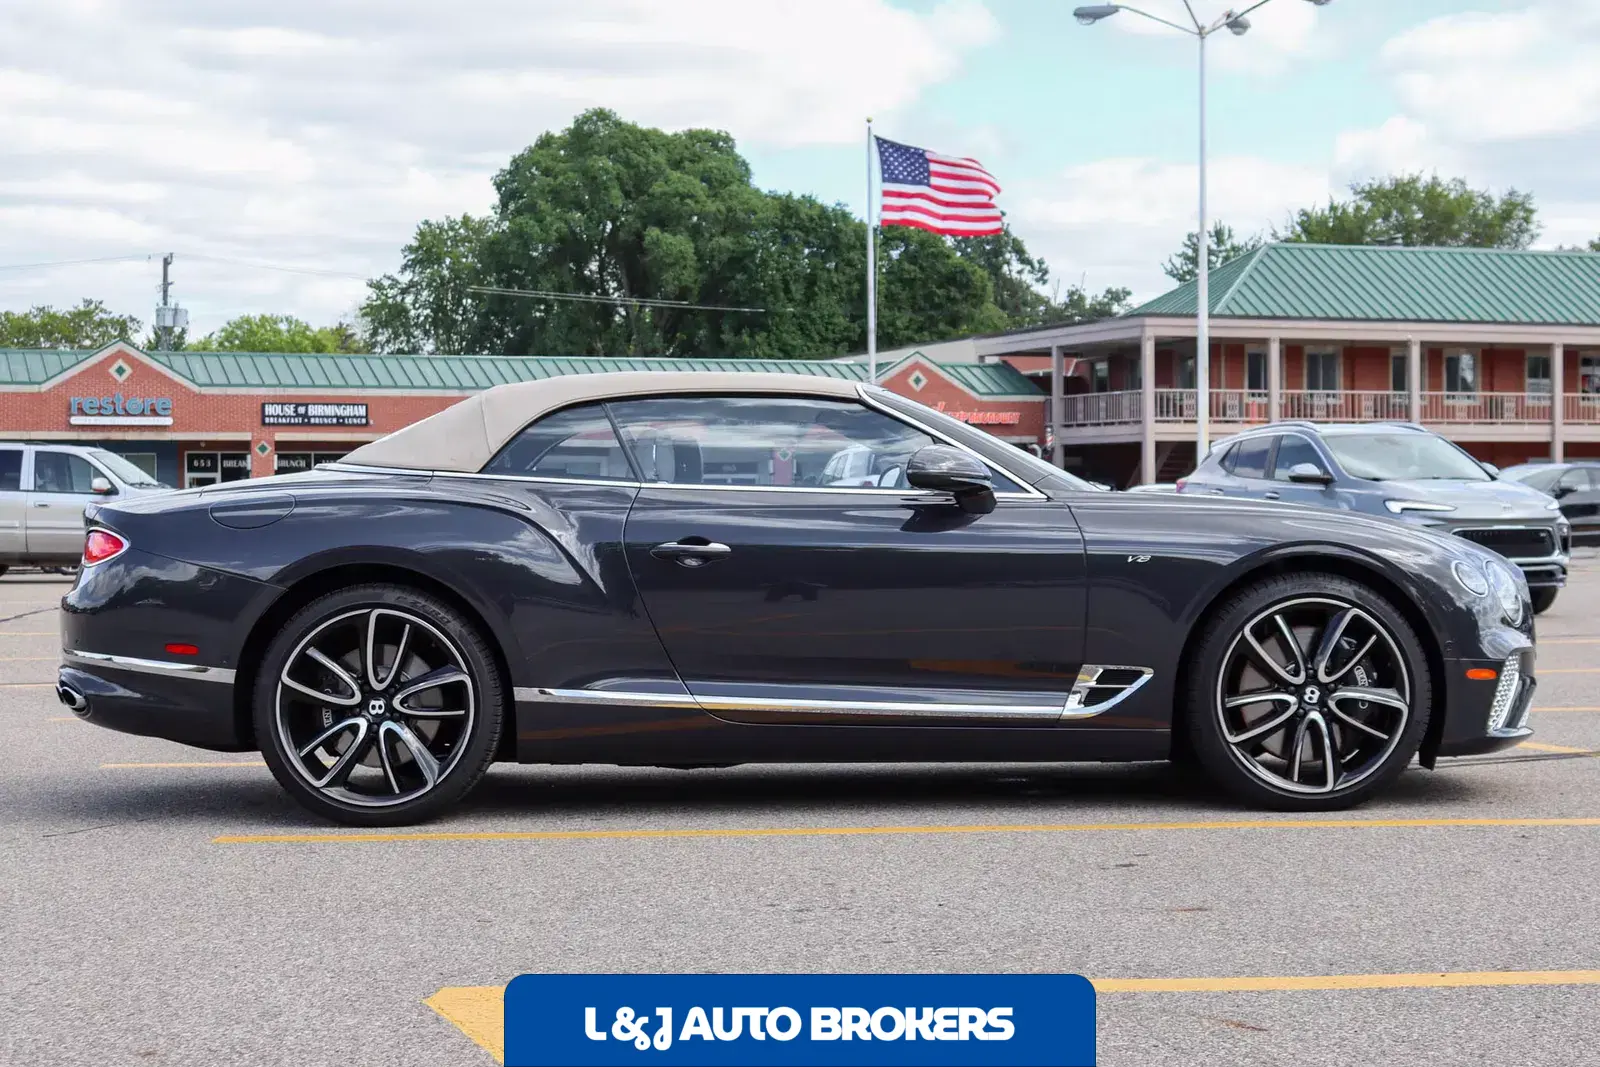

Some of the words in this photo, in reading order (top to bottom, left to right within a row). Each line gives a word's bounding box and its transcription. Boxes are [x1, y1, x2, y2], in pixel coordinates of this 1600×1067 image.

[70, 392, 173, 415] restore
[265, 404, 296, 416] HOUSE
[308, 404, 366, 416] BIRMINGHAM
[1127, 555, 1152, 563] V8
